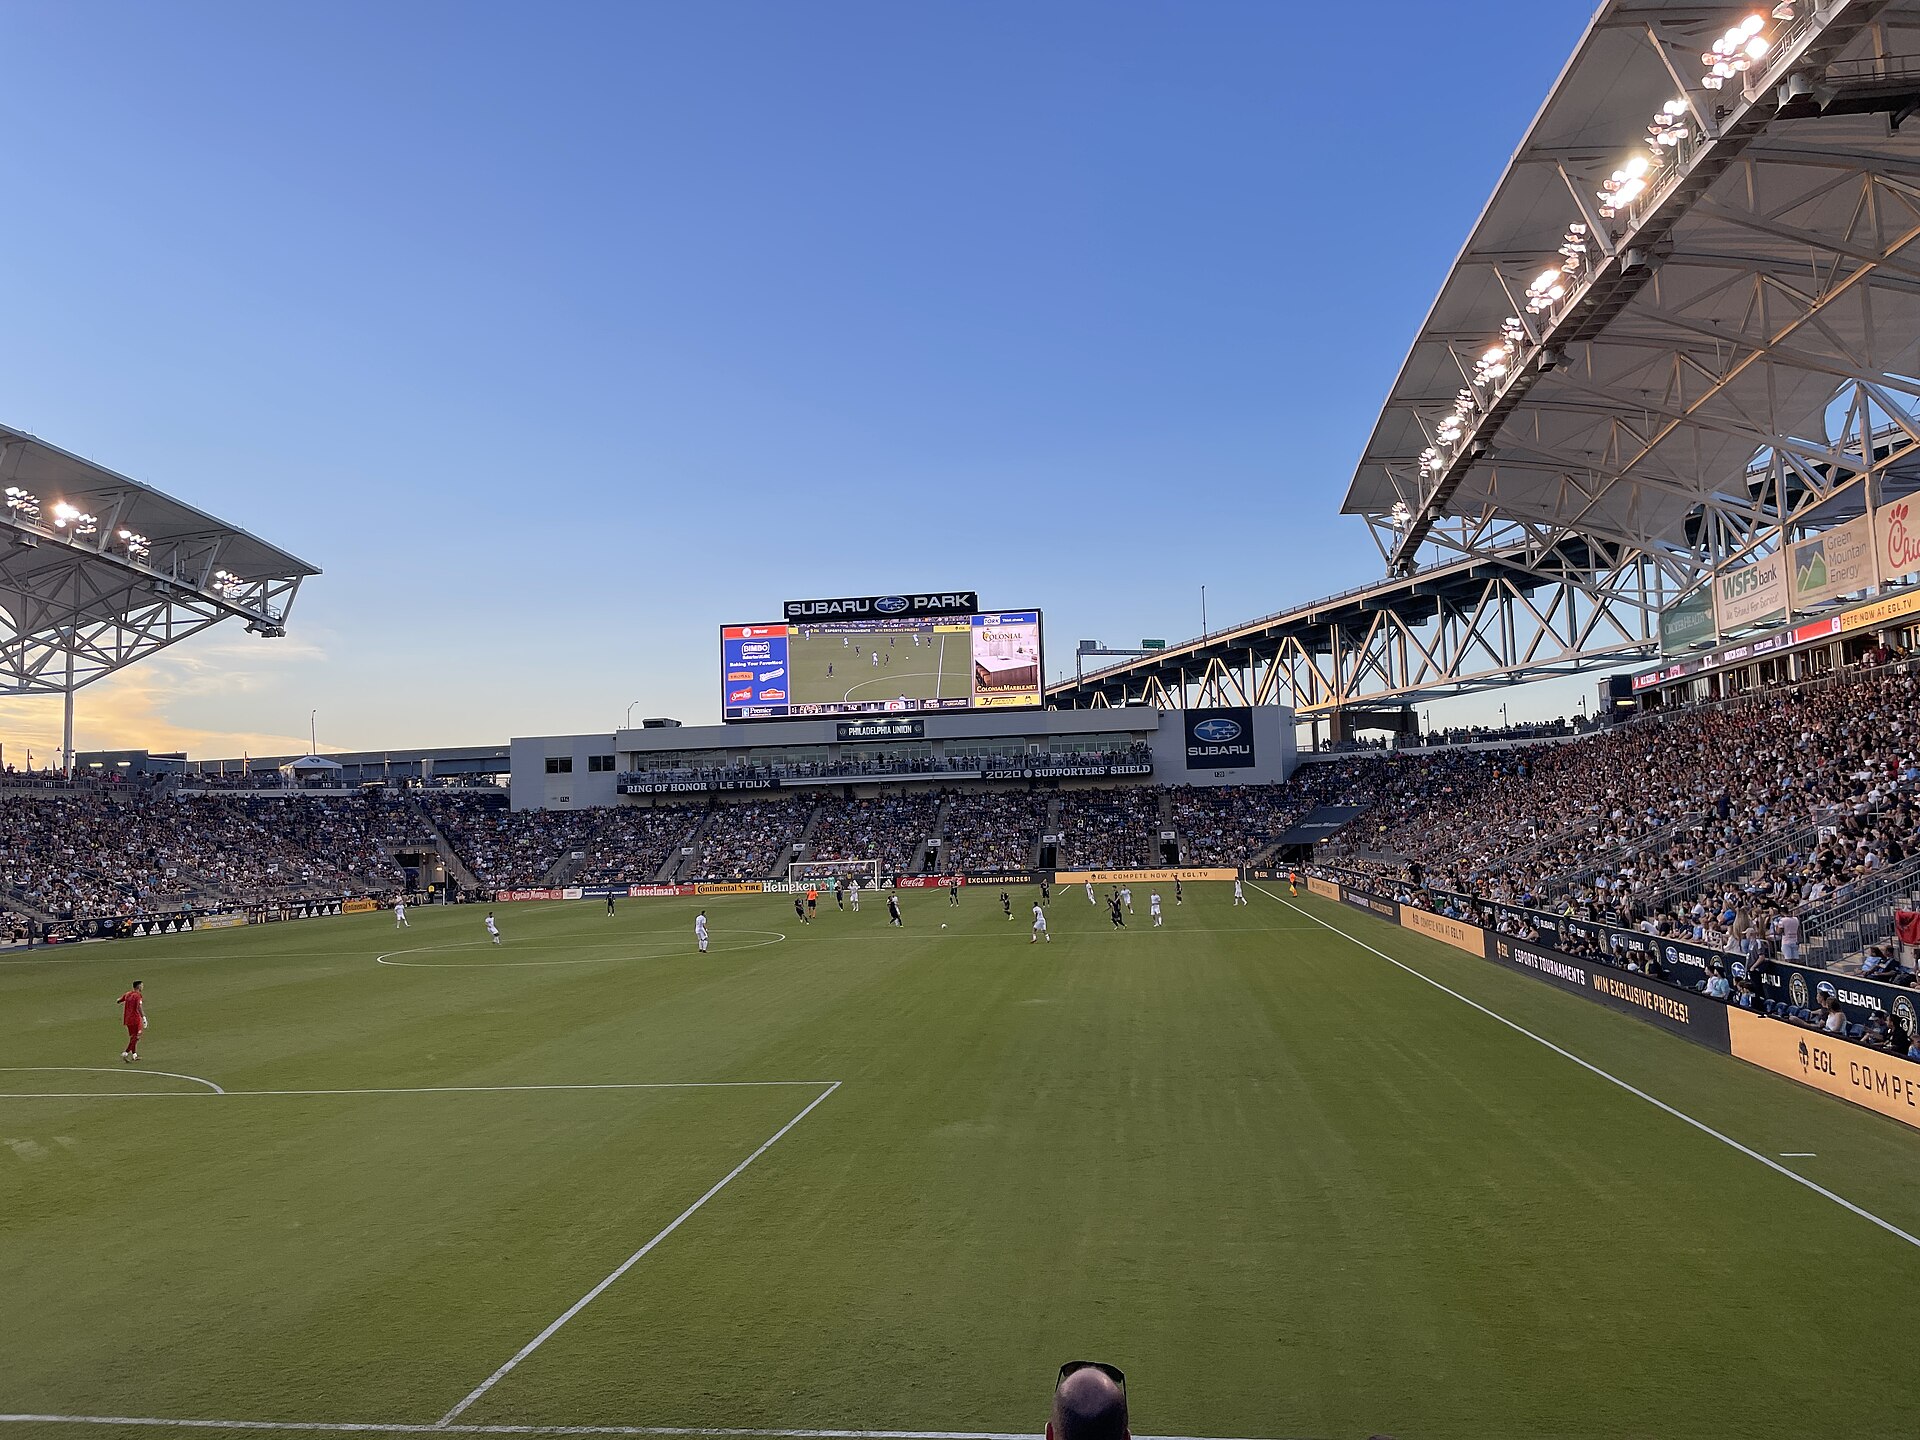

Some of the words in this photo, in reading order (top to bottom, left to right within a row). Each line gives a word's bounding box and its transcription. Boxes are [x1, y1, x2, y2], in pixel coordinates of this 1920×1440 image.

[1827, 530, 1852, 551] Green
[1828, 541, 1867, 568] Mountain
[1829, 563, 1860, 583] Energy
[1723, 566, 1758, 600] WSFS
[1759, 563, 1777, 586] bank
[788, 600, 870, 616] SUBARU
[914, 594, 970, 609] PARK
[1842, 614, 1858, 626] PETE
[1860, 609, 1874, 621] NOW
[1876, 606, 1885, 616] AT
[1887, 599, 1912, 614] EGL.TV
[848, 725, 891, 736] PHILADELPHIA
[892, 724, 912, 734] UNION
[1188, 745, 1250, 756] SUBARU
[985, 770, 1022, 779] 2020
[1034, 766, 1109, 778] SUPPORTERS'
[1110, 764, 1151, 775] SHIELD
[626, 784, 652, 794] RING
[654, 783, 669, 792] OF
[670, 782, 707, 792] HONOR
[719, 781, 733, 790] LE
[736, 780, 771, 789] TOUX
[900, 878, 925, 888] Coca-Cola
[967, 876, 1003, 884] EXCLUSIVE
[1004, 875, 1031, 883] PRIZES!
[511, 891, 530, 900] Captain
[530, 890, 549, 899] Morgan
[629, 884, 680, 897] Musselman's
[698, 883, 737, 894] Continental
[763, 881, 817, 894] Heineken
[1540, 919, 1556, 931] SUBARU
[1679, 951, 1705, 968] SUBARU
[1514, 948, 1538, 969] ESPORTS
[1538, 956, 1585, 986] TOURNAMENTS
[1592, 974, 1608, 993] WIN
[1610, 979, 1653, 1010] EXCLUSIVE
[1653, 994, 1690, 1024] PRIZES!
[1838, 989, 1882, 1010] SUBARU
[1813, 1047, 1836, 1076] EGL
[1850, 1061, 1920, 1107] COMPE
